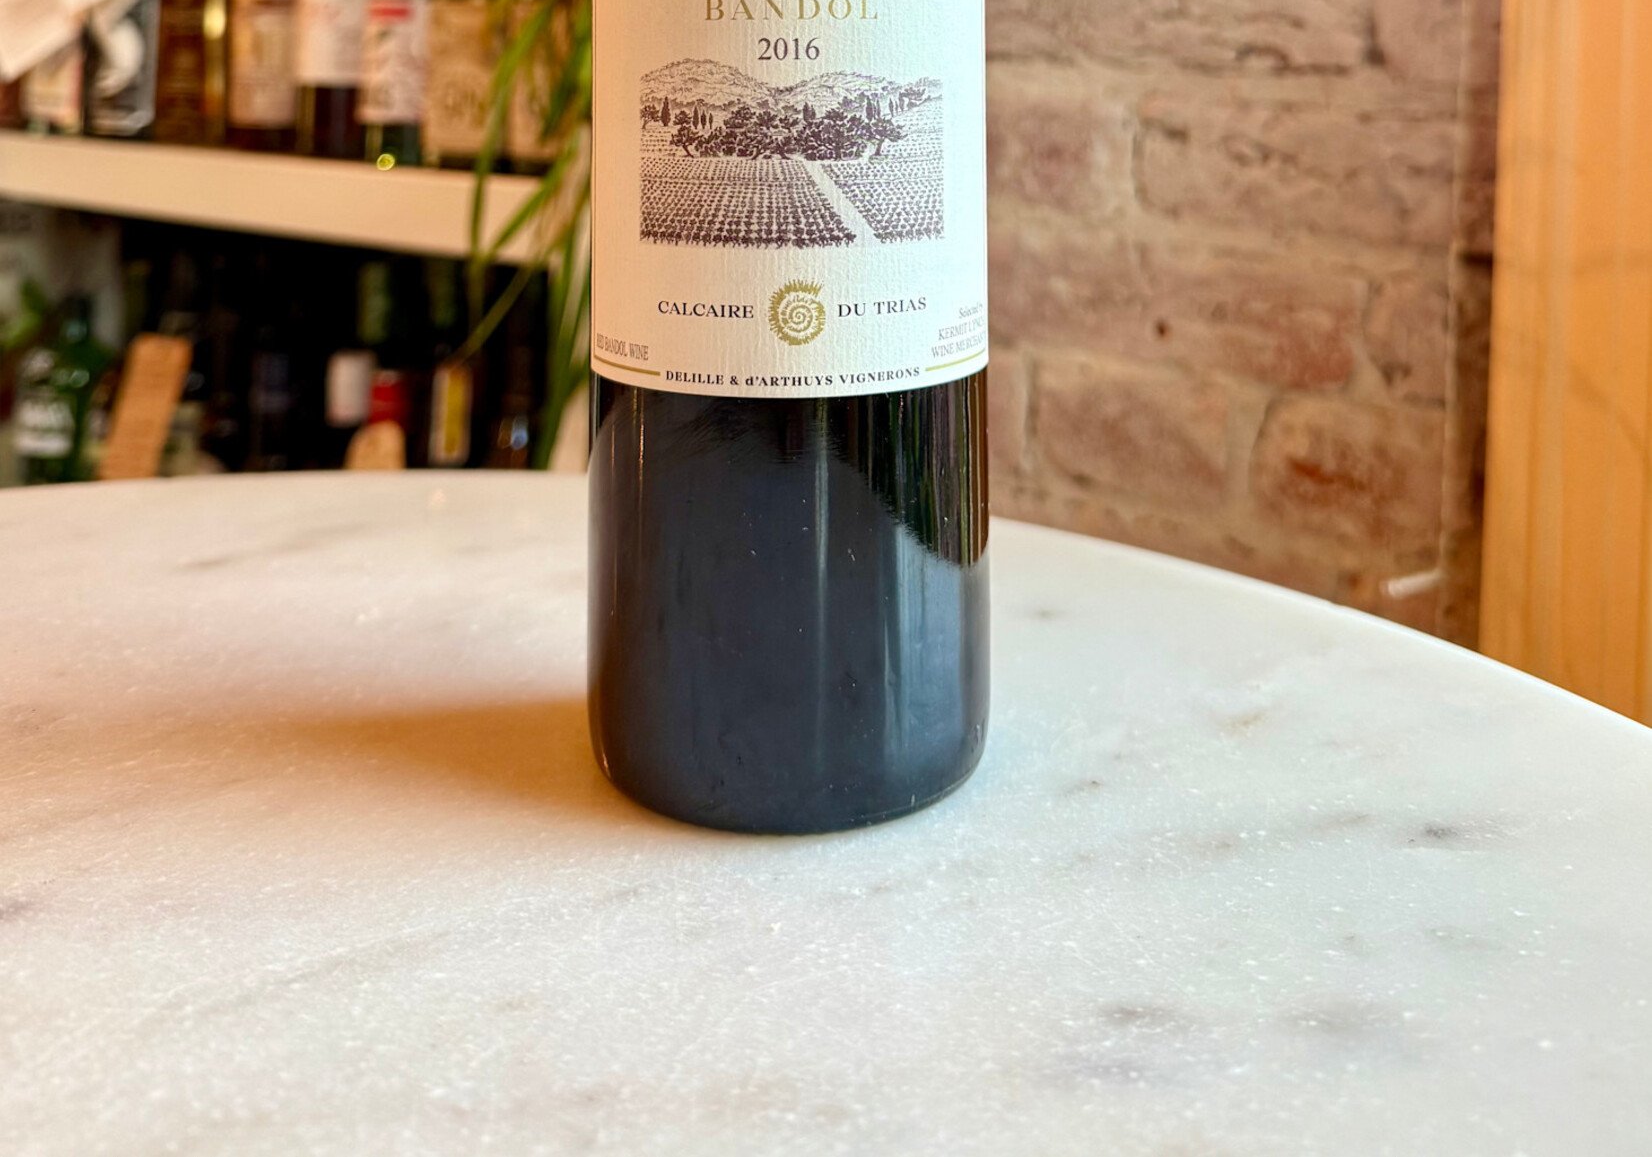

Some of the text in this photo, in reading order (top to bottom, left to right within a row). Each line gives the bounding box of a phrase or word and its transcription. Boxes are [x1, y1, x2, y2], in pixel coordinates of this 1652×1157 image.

[757, 36, 821, 62] 2016
[657, 296, 928, 320] CALCAIRE DU TRIAS
[629, 343, 649, 361] WINE
[931, 342, 955, 359] WINE
[665, 366, 921, 387] DELILLE & d'ARTHUYS VIGNERONS
